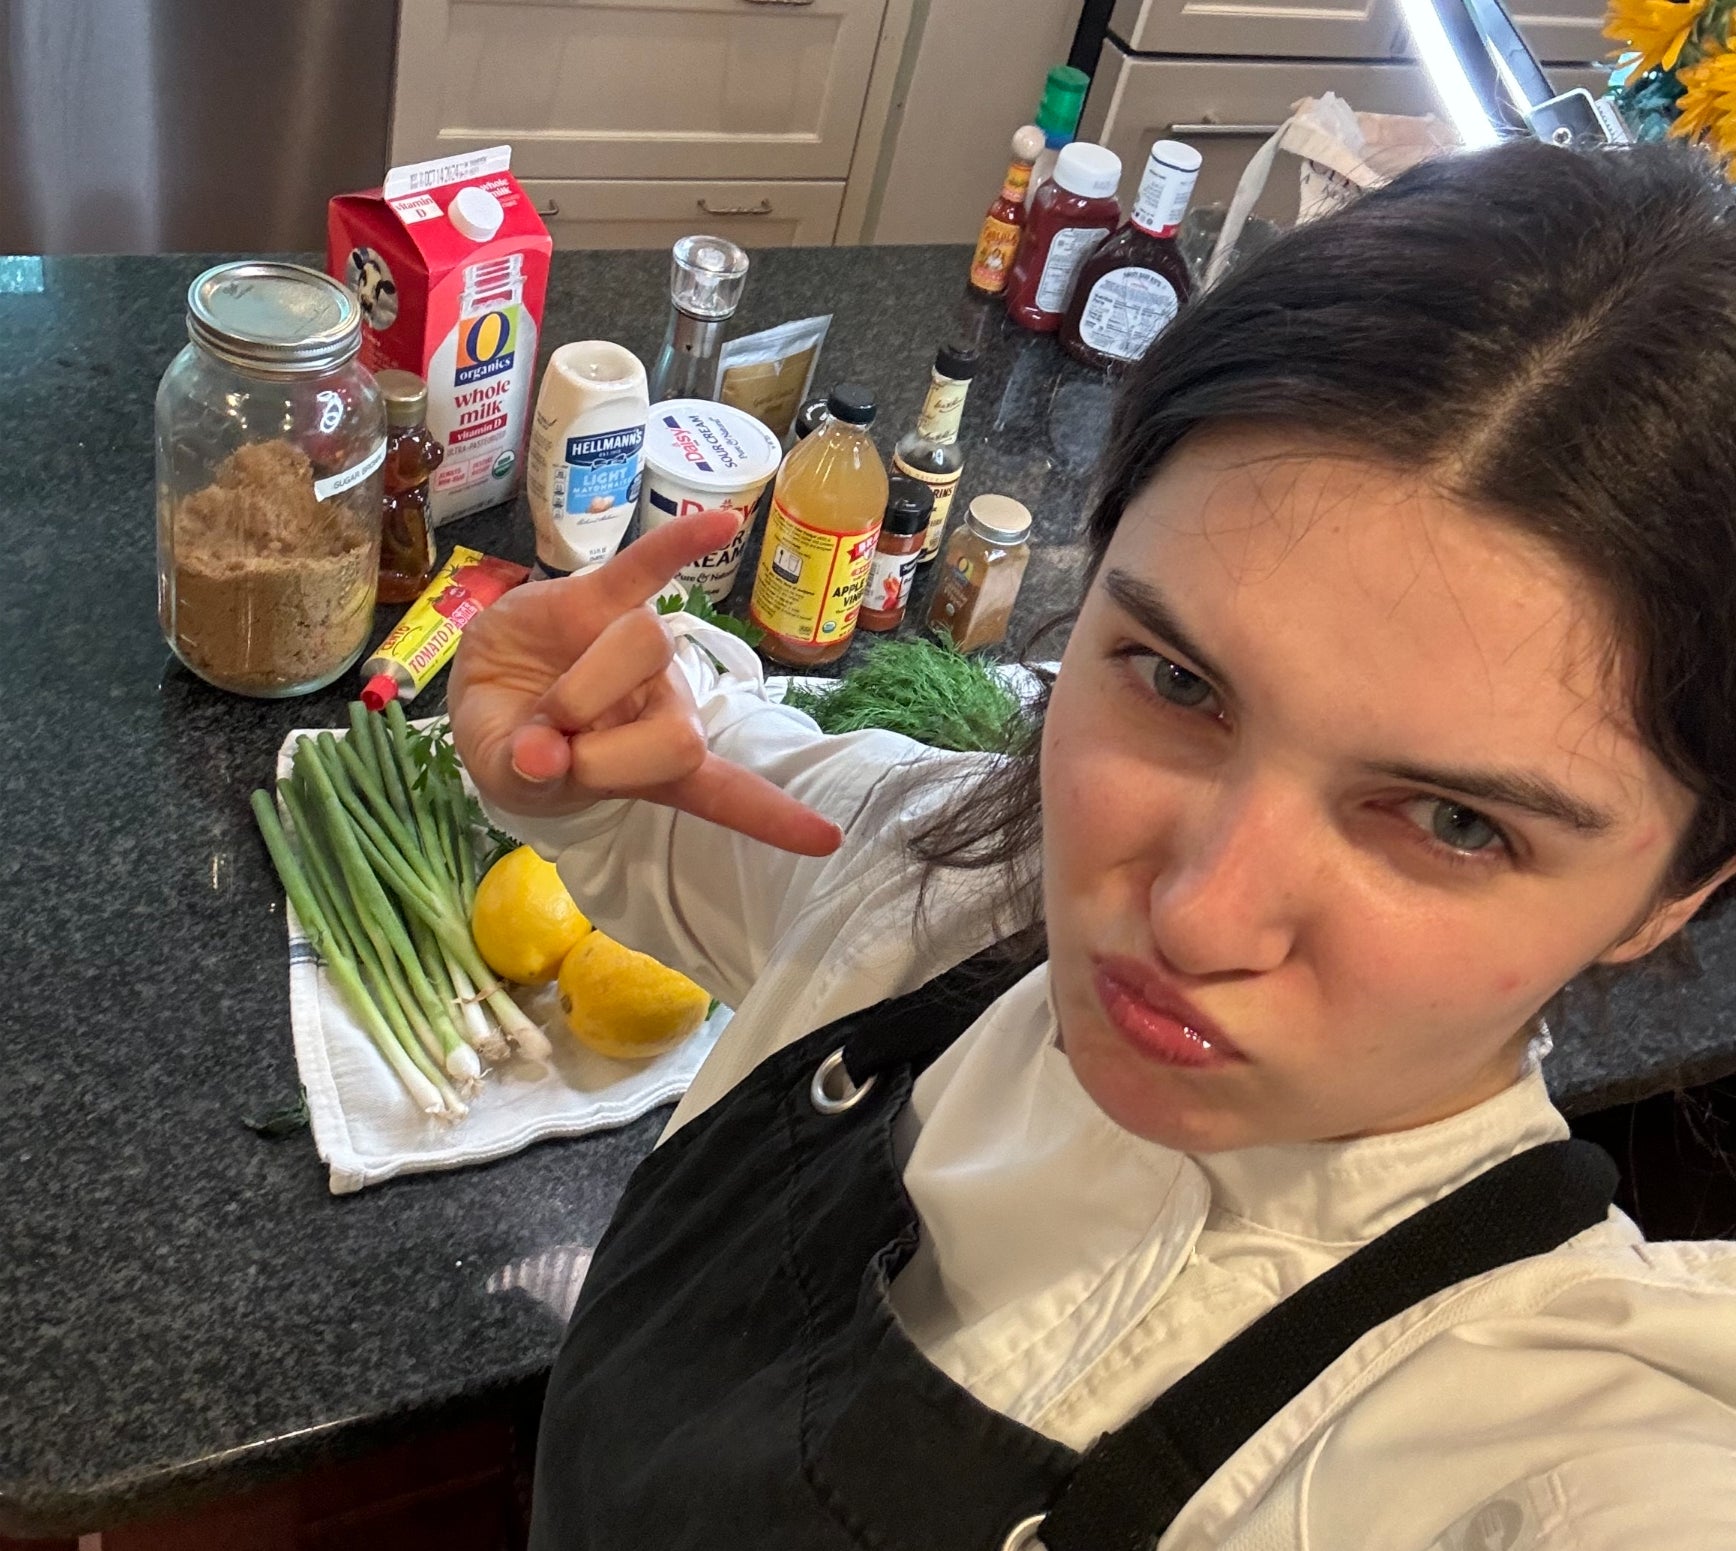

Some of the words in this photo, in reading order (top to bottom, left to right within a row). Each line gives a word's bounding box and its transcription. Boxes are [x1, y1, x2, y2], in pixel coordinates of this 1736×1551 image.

[395, 197, 434, 211] vitamin
[415, 209, 427, 219] D
[466, 311, 510, 364] O
[459, 357, 511, 383] organics
[454, 379, 511, 409] whole
[459, 400, 503, 428] milk
[457, 422, 494, 441] vitamin
[493, 418, 503, 430] D
[571, 429, 643, 456] HELLMANN'S
[688, 415, 719, 445] CREAM
[670, 427, 705, 462] Daisy
[712, 444, 738, 469] SOUR
[333, 470, 361, 489] SUGAR
[583, 467, 629, 486] LIGHT
[933, 486, 954, 500] RINS
[408, 630, 449, 674] TOMATO
[447, 600, 478, 633] PASTE
